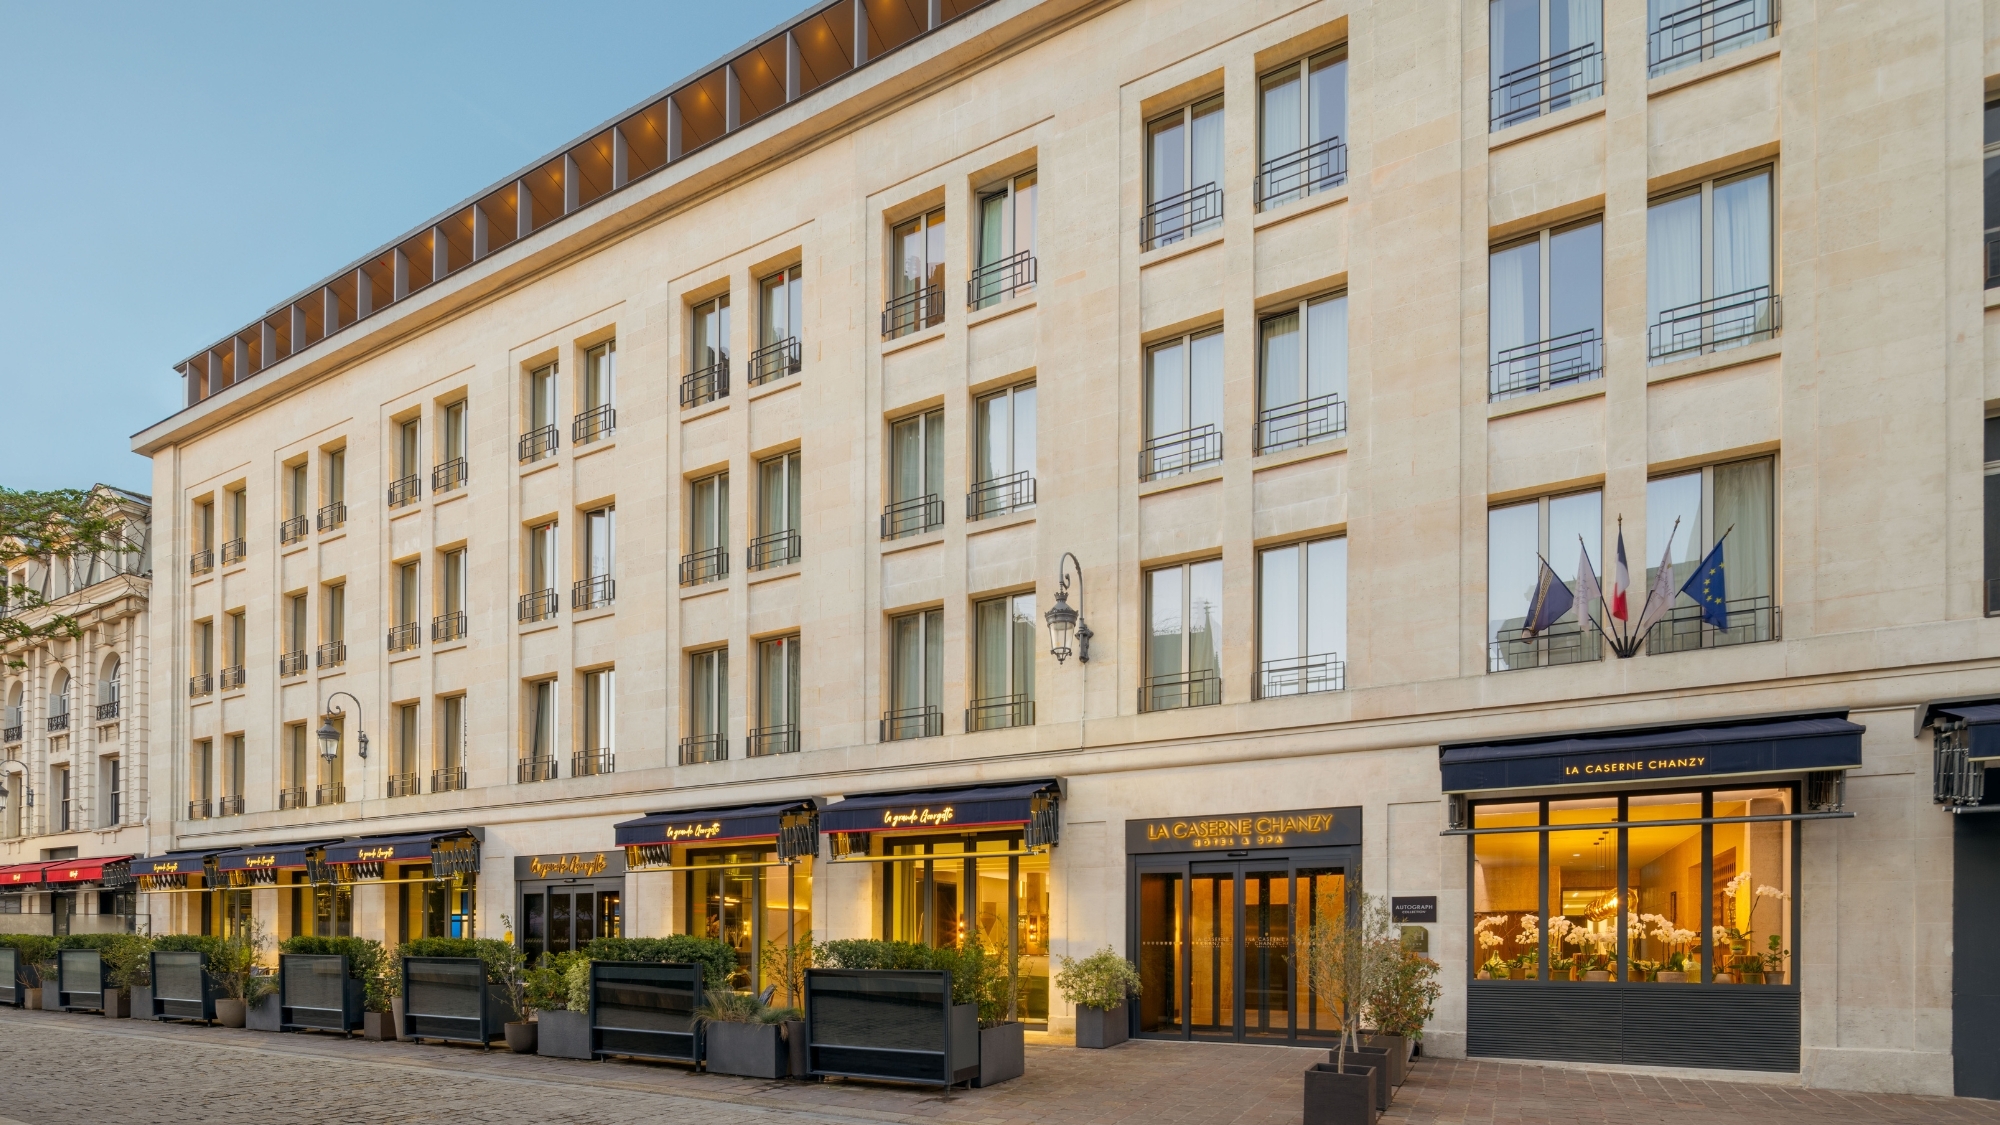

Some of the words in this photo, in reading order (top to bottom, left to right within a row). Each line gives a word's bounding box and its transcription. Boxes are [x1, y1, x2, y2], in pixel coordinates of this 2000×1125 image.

[1565, 766, 1579, 775] LA
[1585, 761, 1643, 774] CASERNE
[1648, 757, 1705, 769] CHANZY
[892, 809, 918, 827] grande
[920, 807, 954, 825] Georgette
[1148, 823, 1170, 840] LA
[1172, 819, 1252, 838] CASERNE
[1255, 814, 1333, 835] CHANZY
[1241, 837, 1250, 845] &
[1257, 835, 1283, 844] SPA
